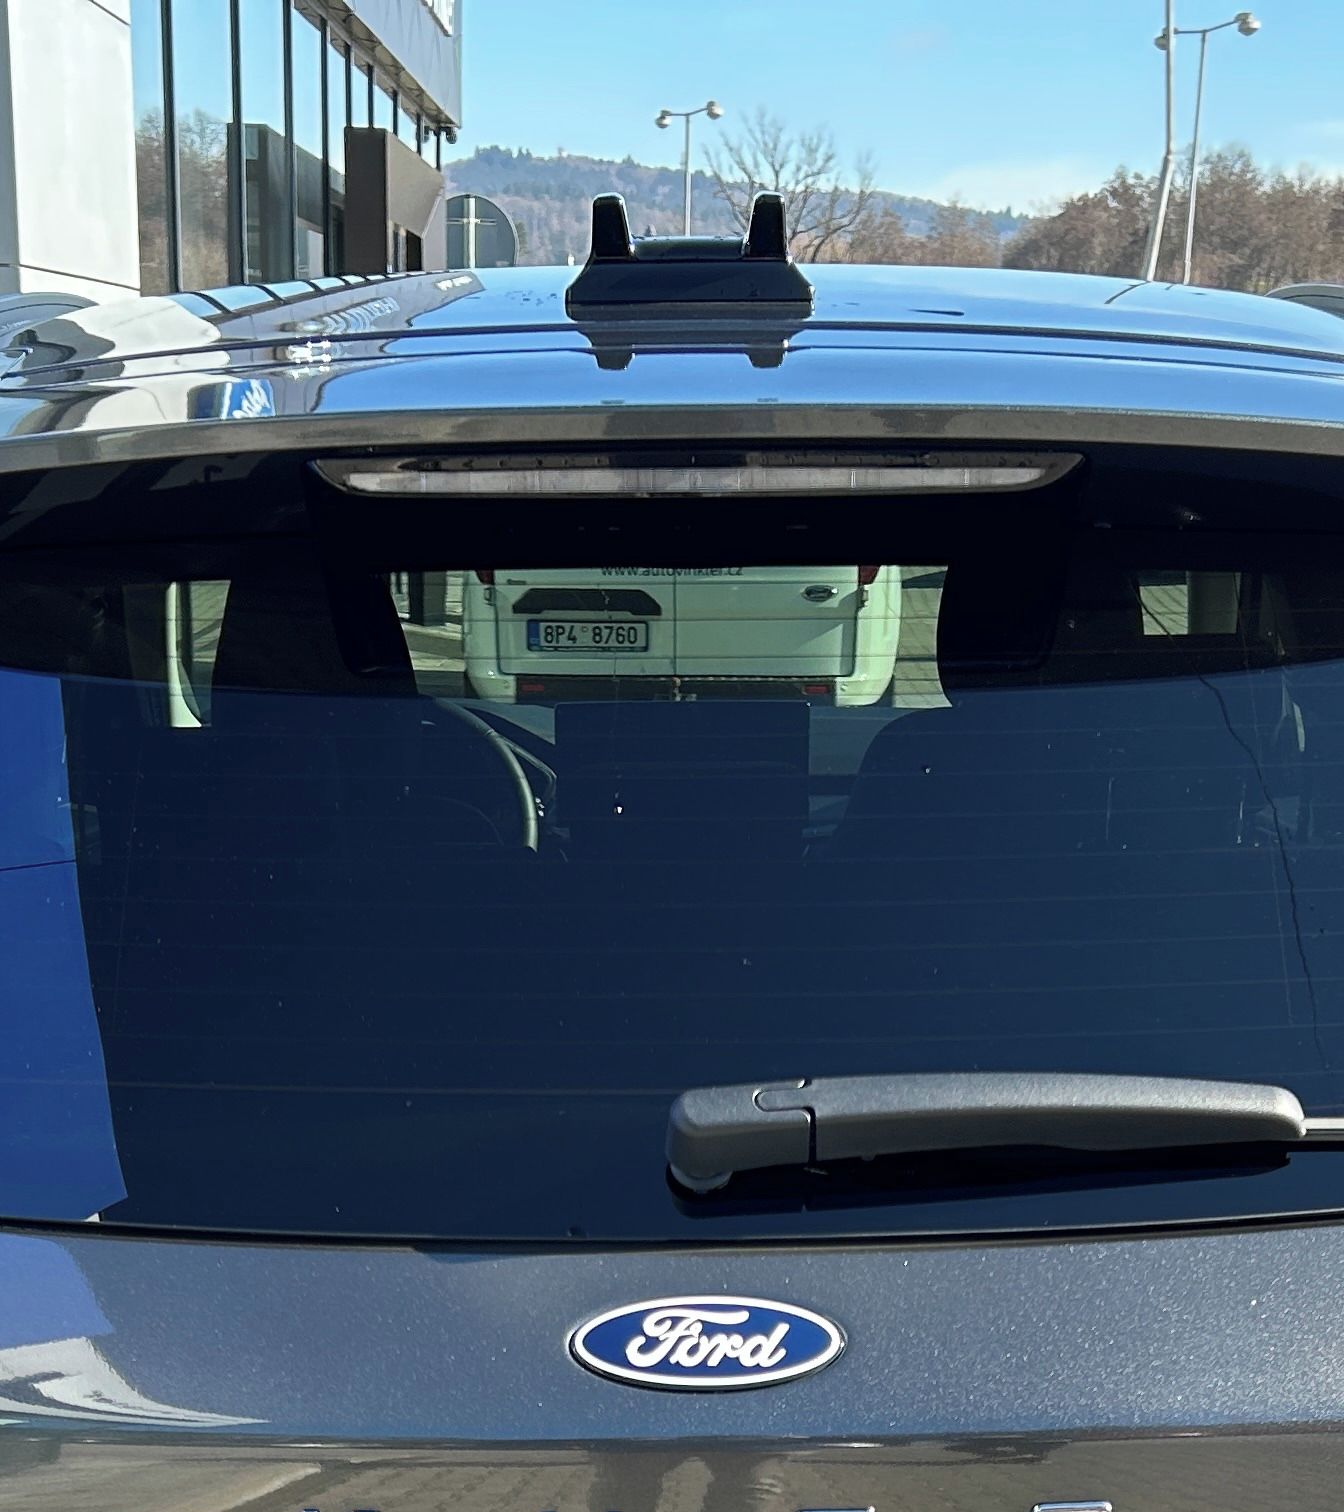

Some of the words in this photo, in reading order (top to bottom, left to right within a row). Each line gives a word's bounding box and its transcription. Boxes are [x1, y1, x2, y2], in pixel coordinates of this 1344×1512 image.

[543, 626, 578, 644] 8P4
[592, 626, 638, 645] 8760
[625, 1306, 787, 1369] Ford
